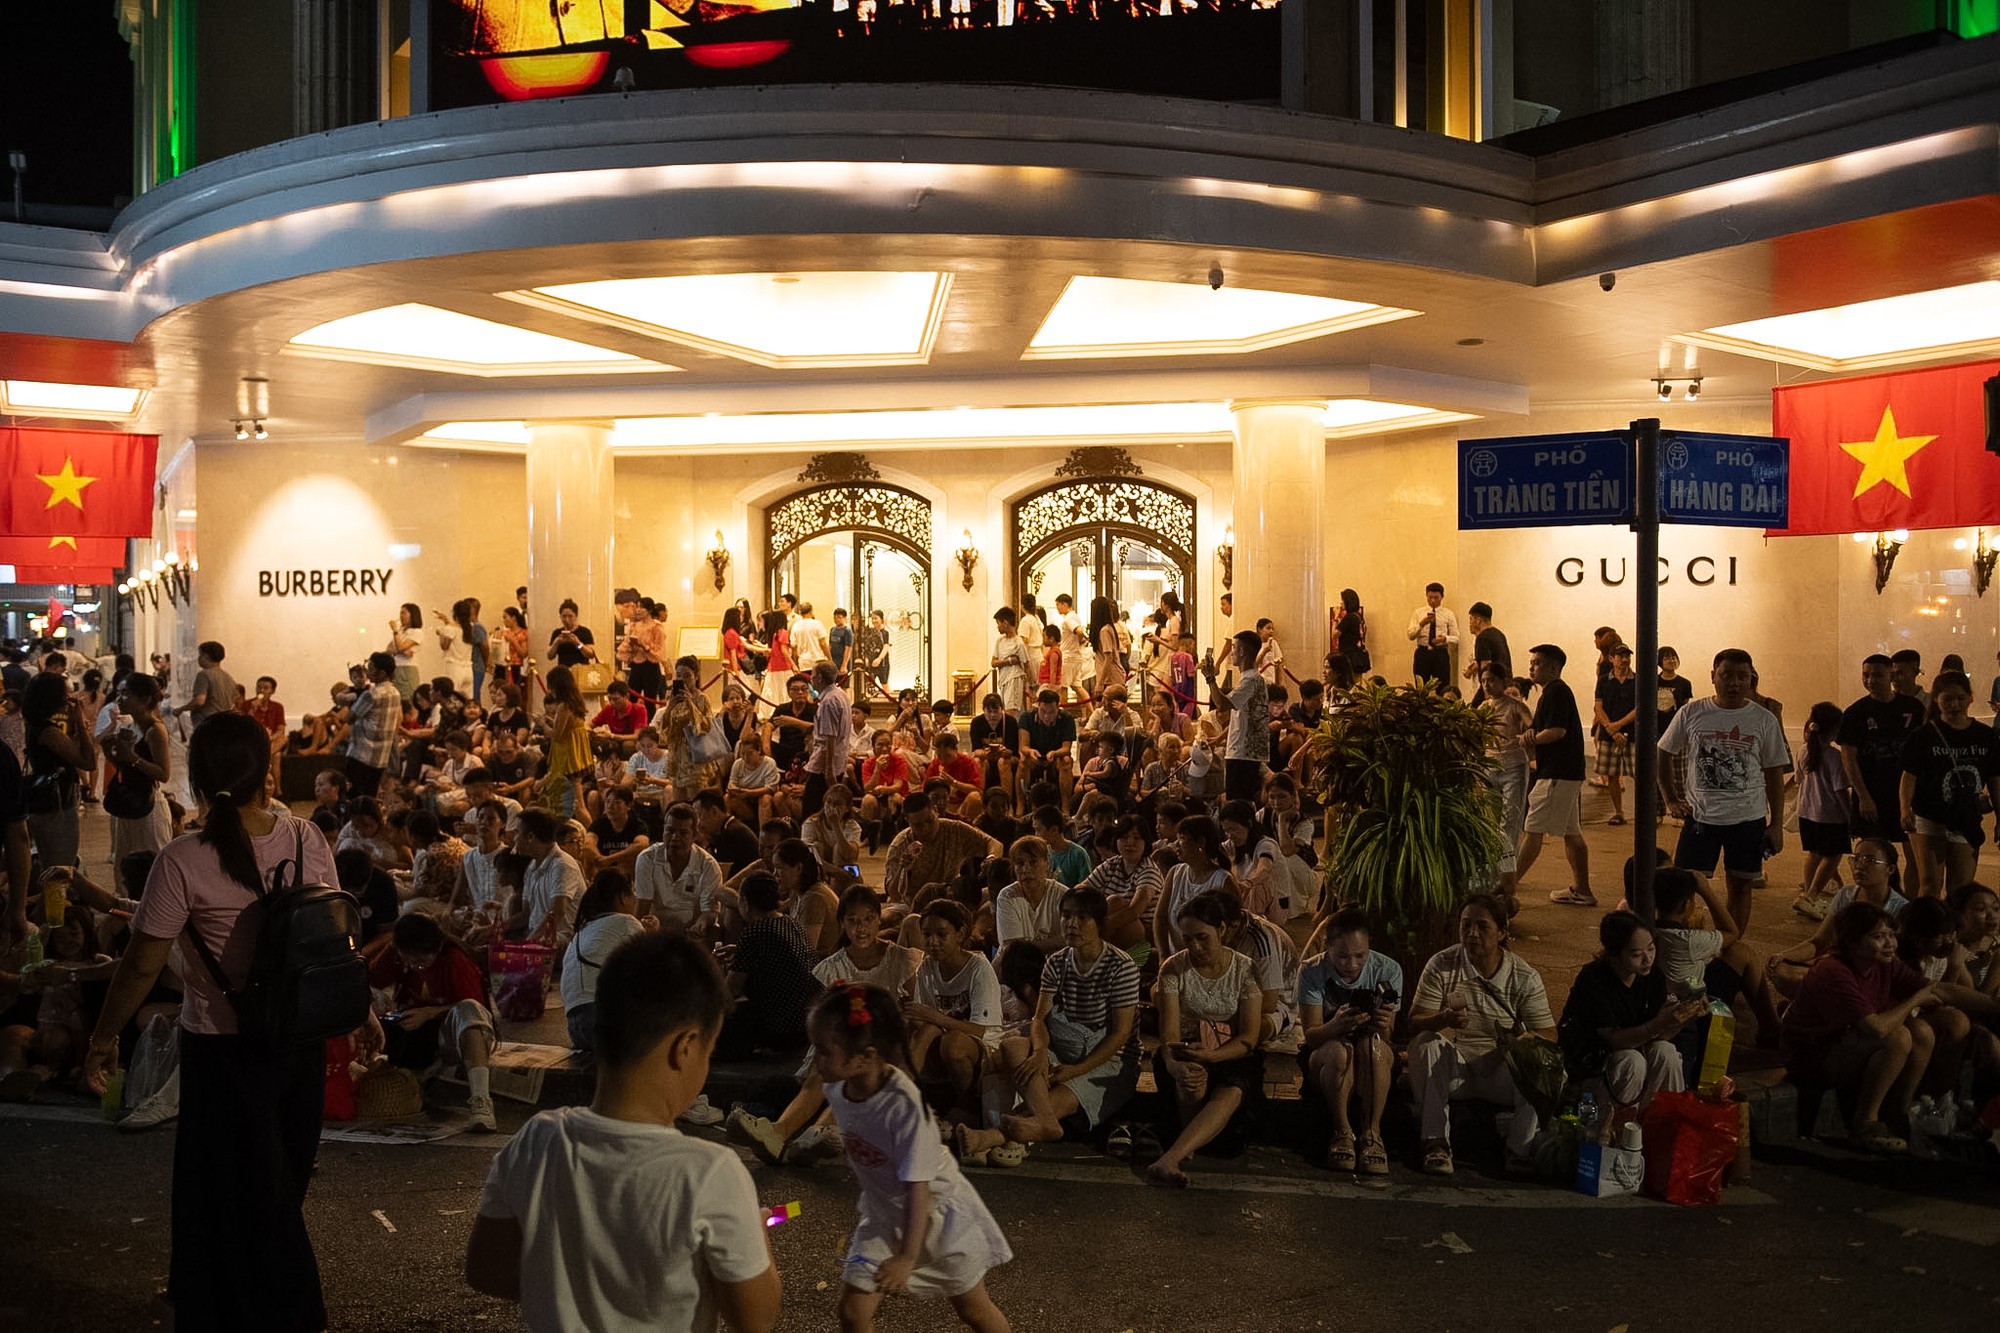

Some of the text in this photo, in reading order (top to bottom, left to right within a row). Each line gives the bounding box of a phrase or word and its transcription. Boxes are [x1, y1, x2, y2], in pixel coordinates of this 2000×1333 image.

[1534, 442, 1588, 467] PHỐ
[1716, 446, 1756, 467] PHỐ
[1473, 469, 1620, 515] TRÀNG TIỀN
[1670, 472, 1778, 514] HÀNG BÀI
[259, 569, 393, 597] BURBERRY
[1902, 712, 1914, 729] 7
